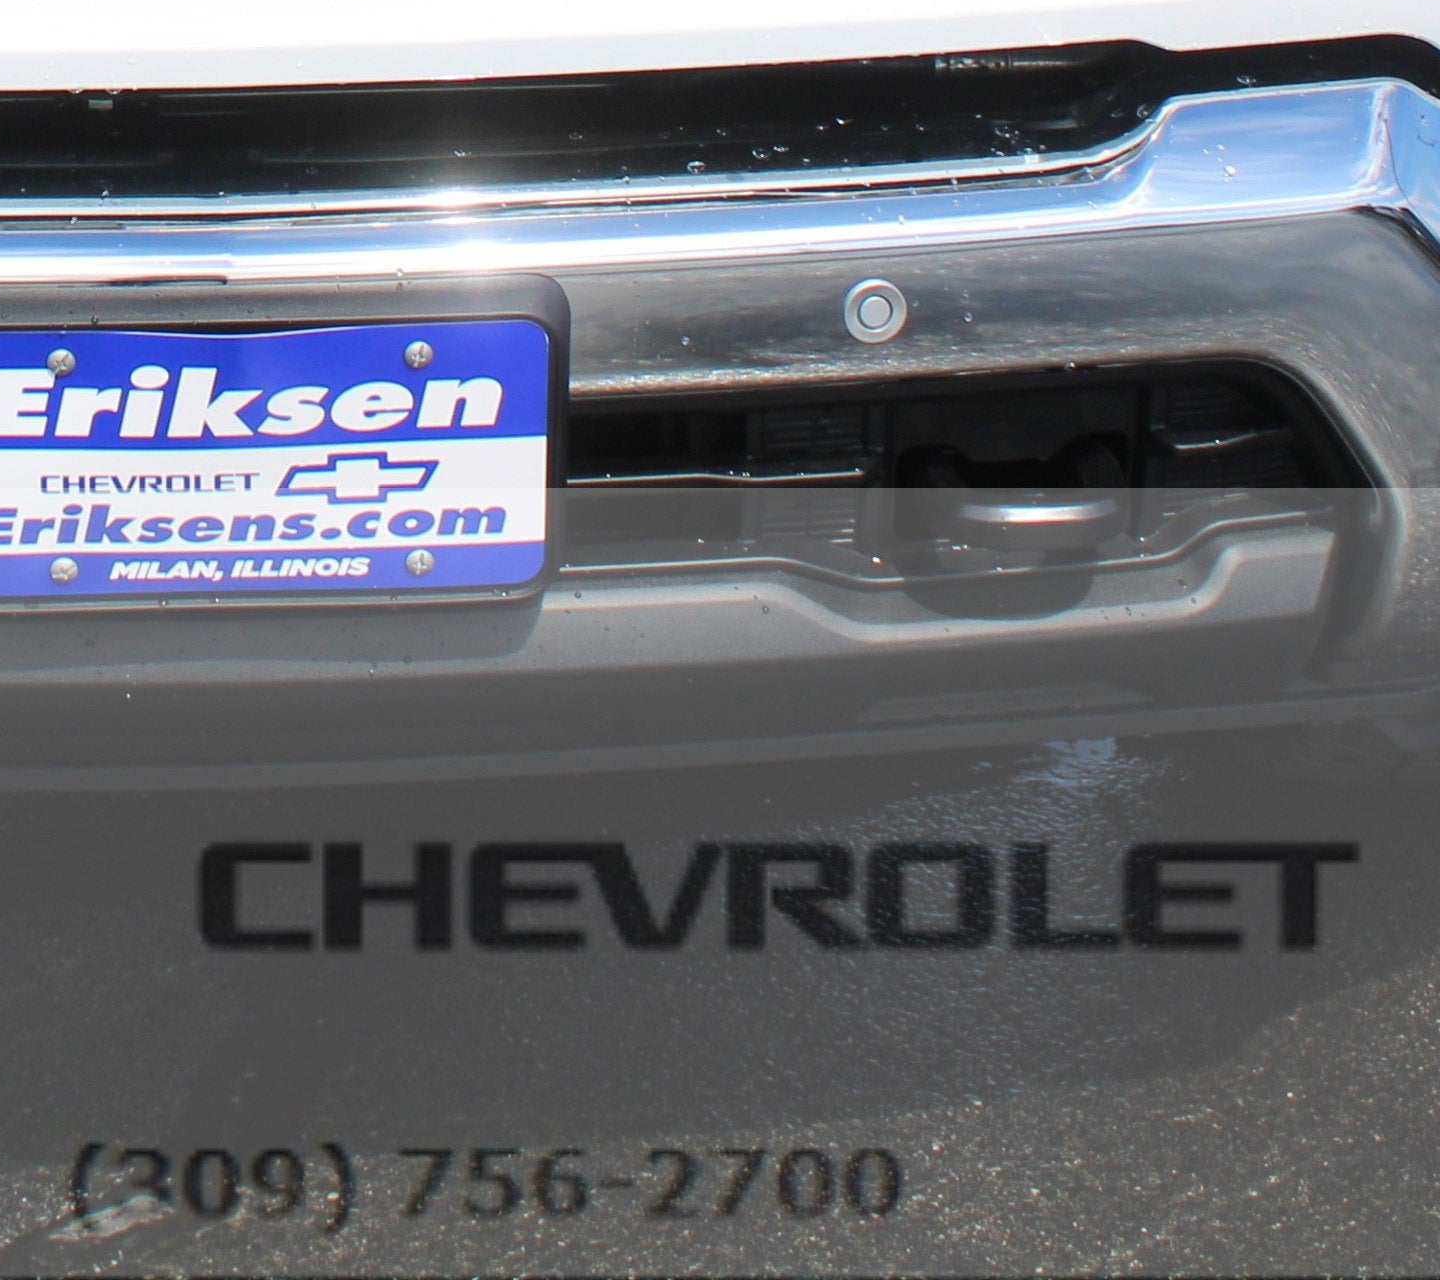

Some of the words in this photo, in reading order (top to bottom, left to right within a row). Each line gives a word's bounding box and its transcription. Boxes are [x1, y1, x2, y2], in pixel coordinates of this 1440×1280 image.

[39, 471, 261, 495] CHEVROLET
[109, 557, 224, 582] MILAN,
[230, 555, 371, 578] ILLINOIS
